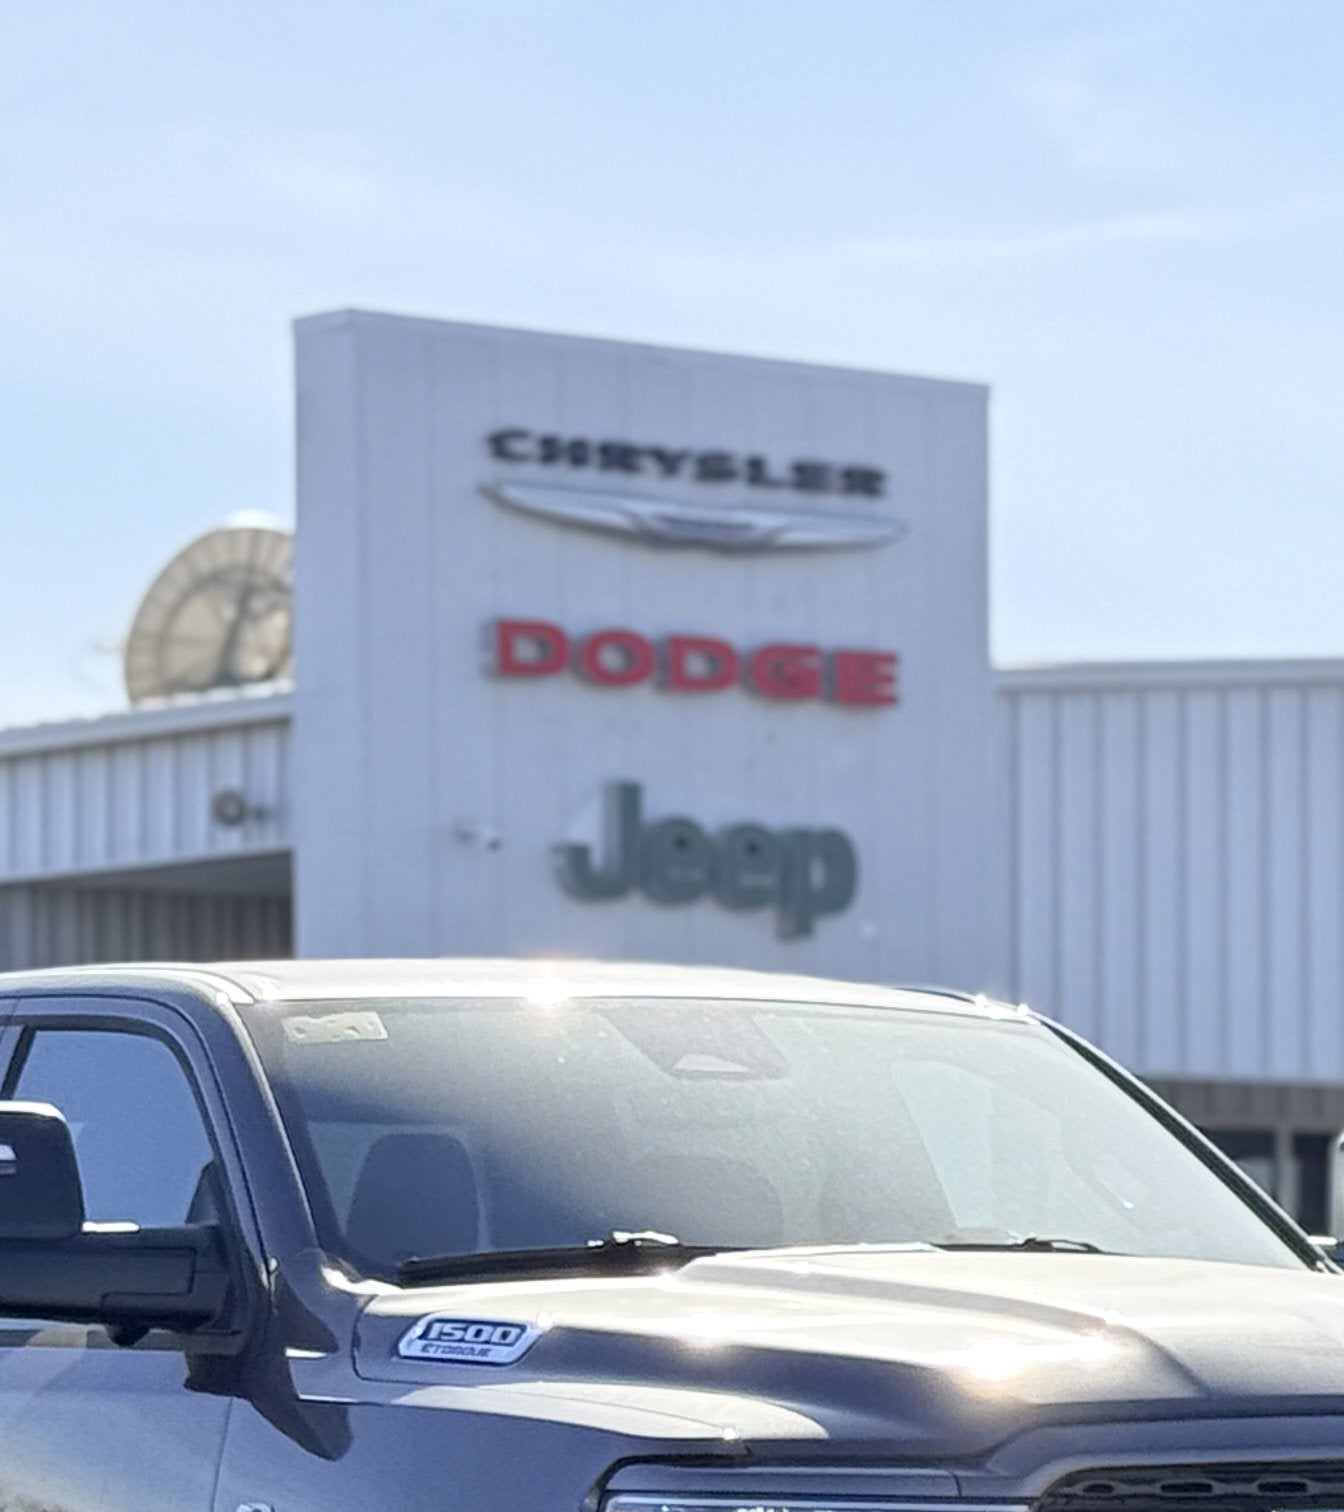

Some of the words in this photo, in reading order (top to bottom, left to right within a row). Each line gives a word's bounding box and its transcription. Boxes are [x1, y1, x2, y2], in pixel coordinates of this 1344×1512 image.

[485, 428, 887, 498] CHRYSLER
[486, 618, 900, 710] DODGE
[553, 780, 860, 942] Jeep
[427, 1322, 520, 1345] 1500
